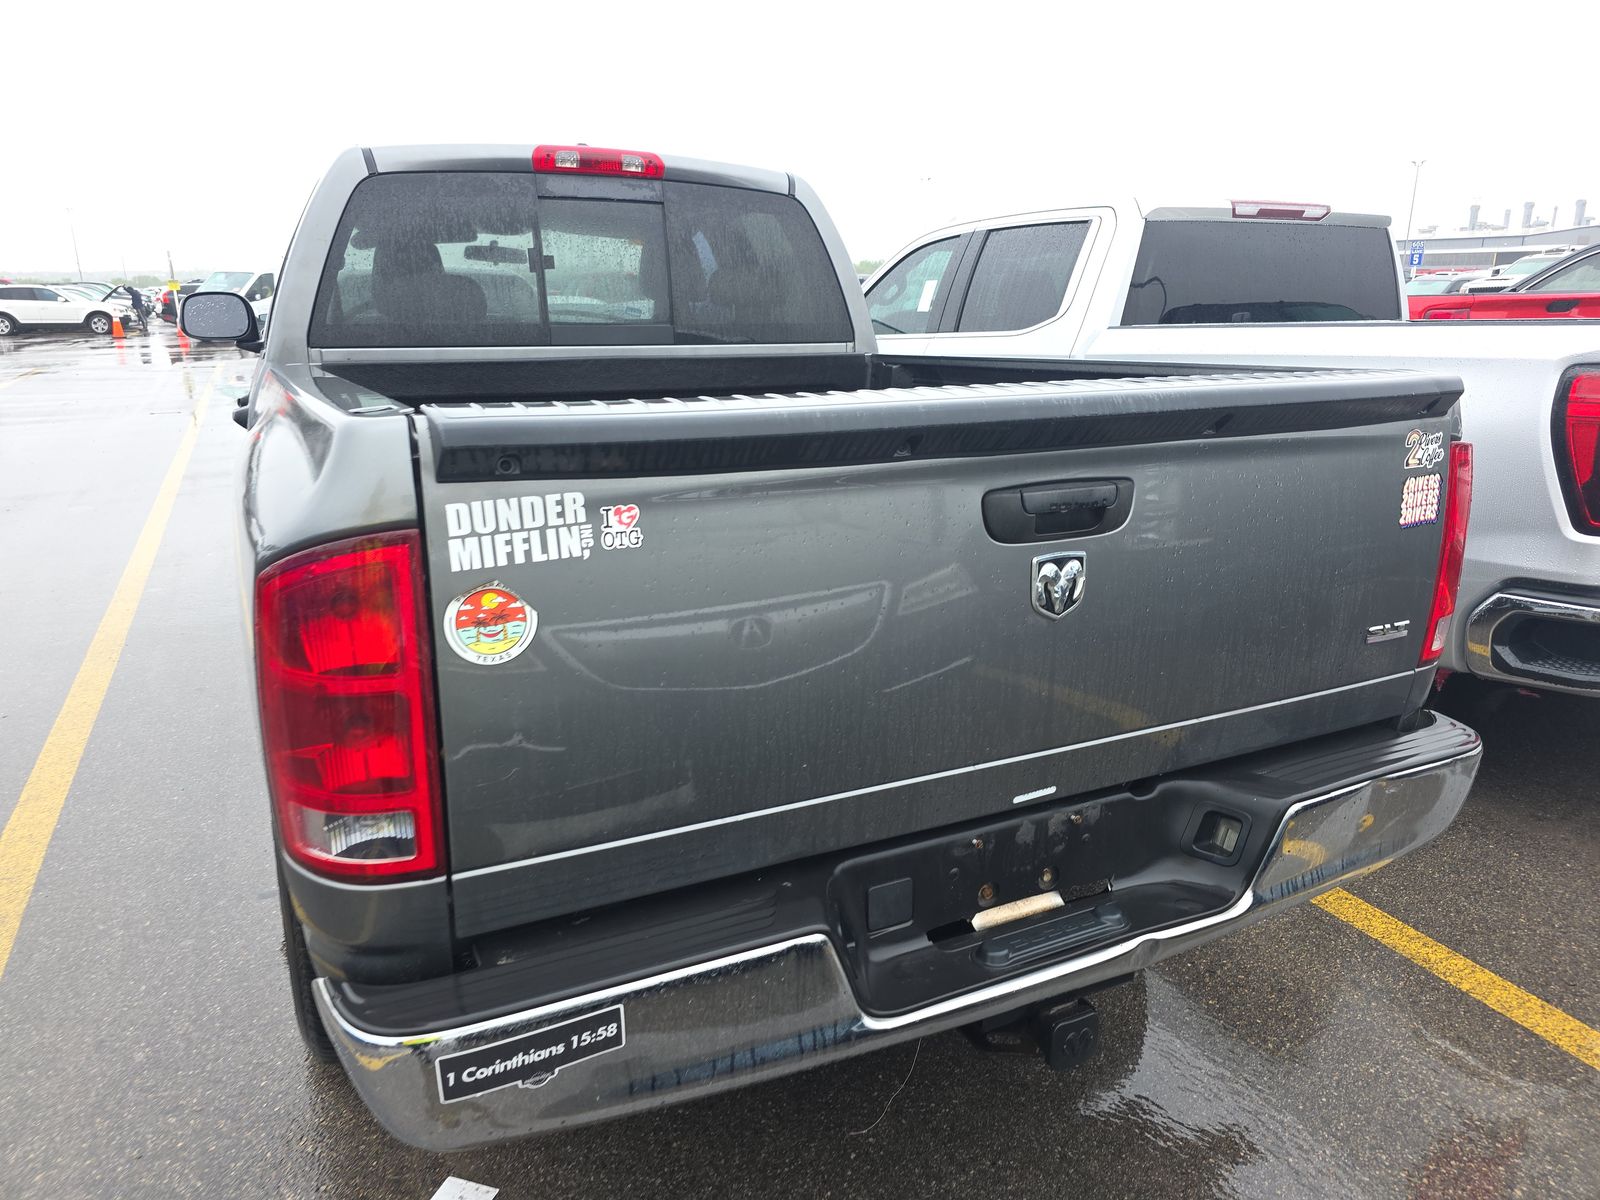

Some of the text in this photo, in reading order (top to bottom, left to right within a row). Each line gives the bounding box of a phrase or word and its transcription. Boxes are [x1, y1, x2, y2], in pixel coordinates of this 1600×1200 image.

[1413, 254, 1420, 264] 5
[445, 492, 587, 537] DUNDER
[603, 530, 641, 548] OTG
[476, 652, 512, 662] TEXAS
[447, 1072, 455, 1087] 1
[462, 1042, 565, 1083] Corinthians
[570, 1022, 618, 1050] 15:58
